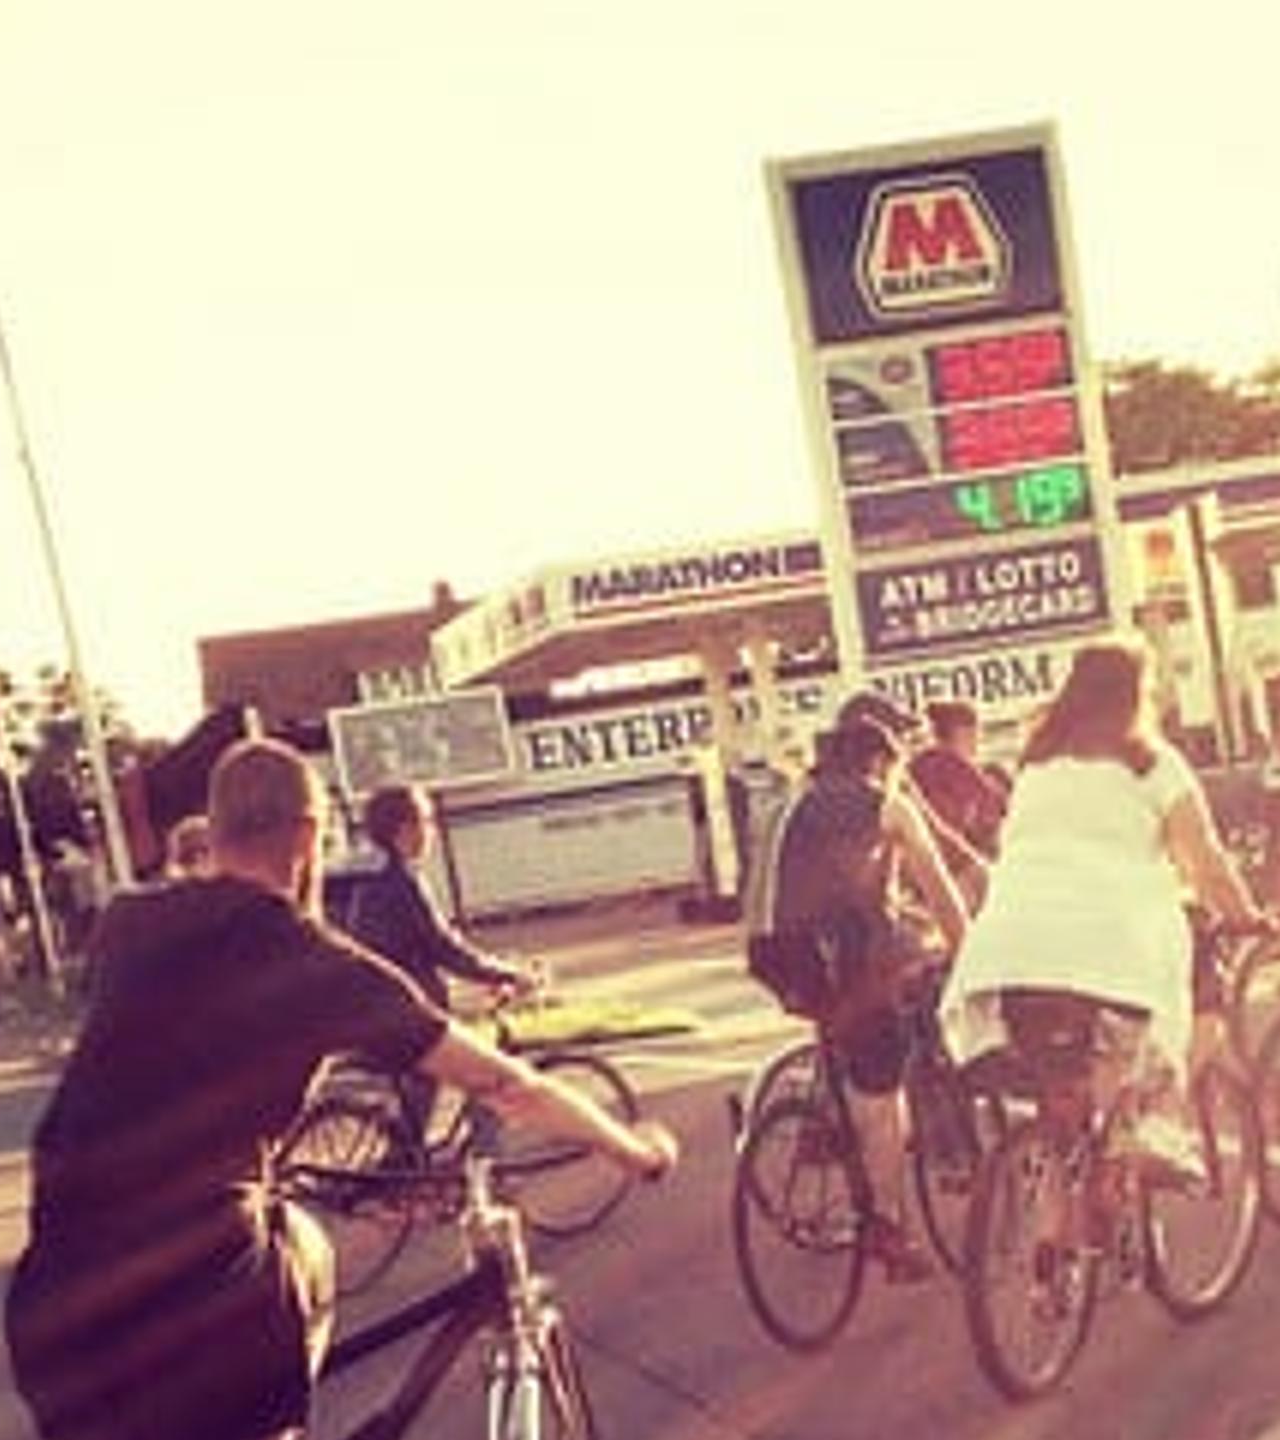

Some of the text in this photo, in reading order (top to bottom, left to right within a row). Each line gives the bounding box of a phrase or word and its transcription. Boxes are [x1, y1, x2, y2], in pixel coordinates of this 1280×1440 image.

[884, 197, 983, 271] M
[571, 547, 781, 606] MARATHON
[881, 573, 948, 607] ATM
[977, 554, 1079, 593] LOTTO
